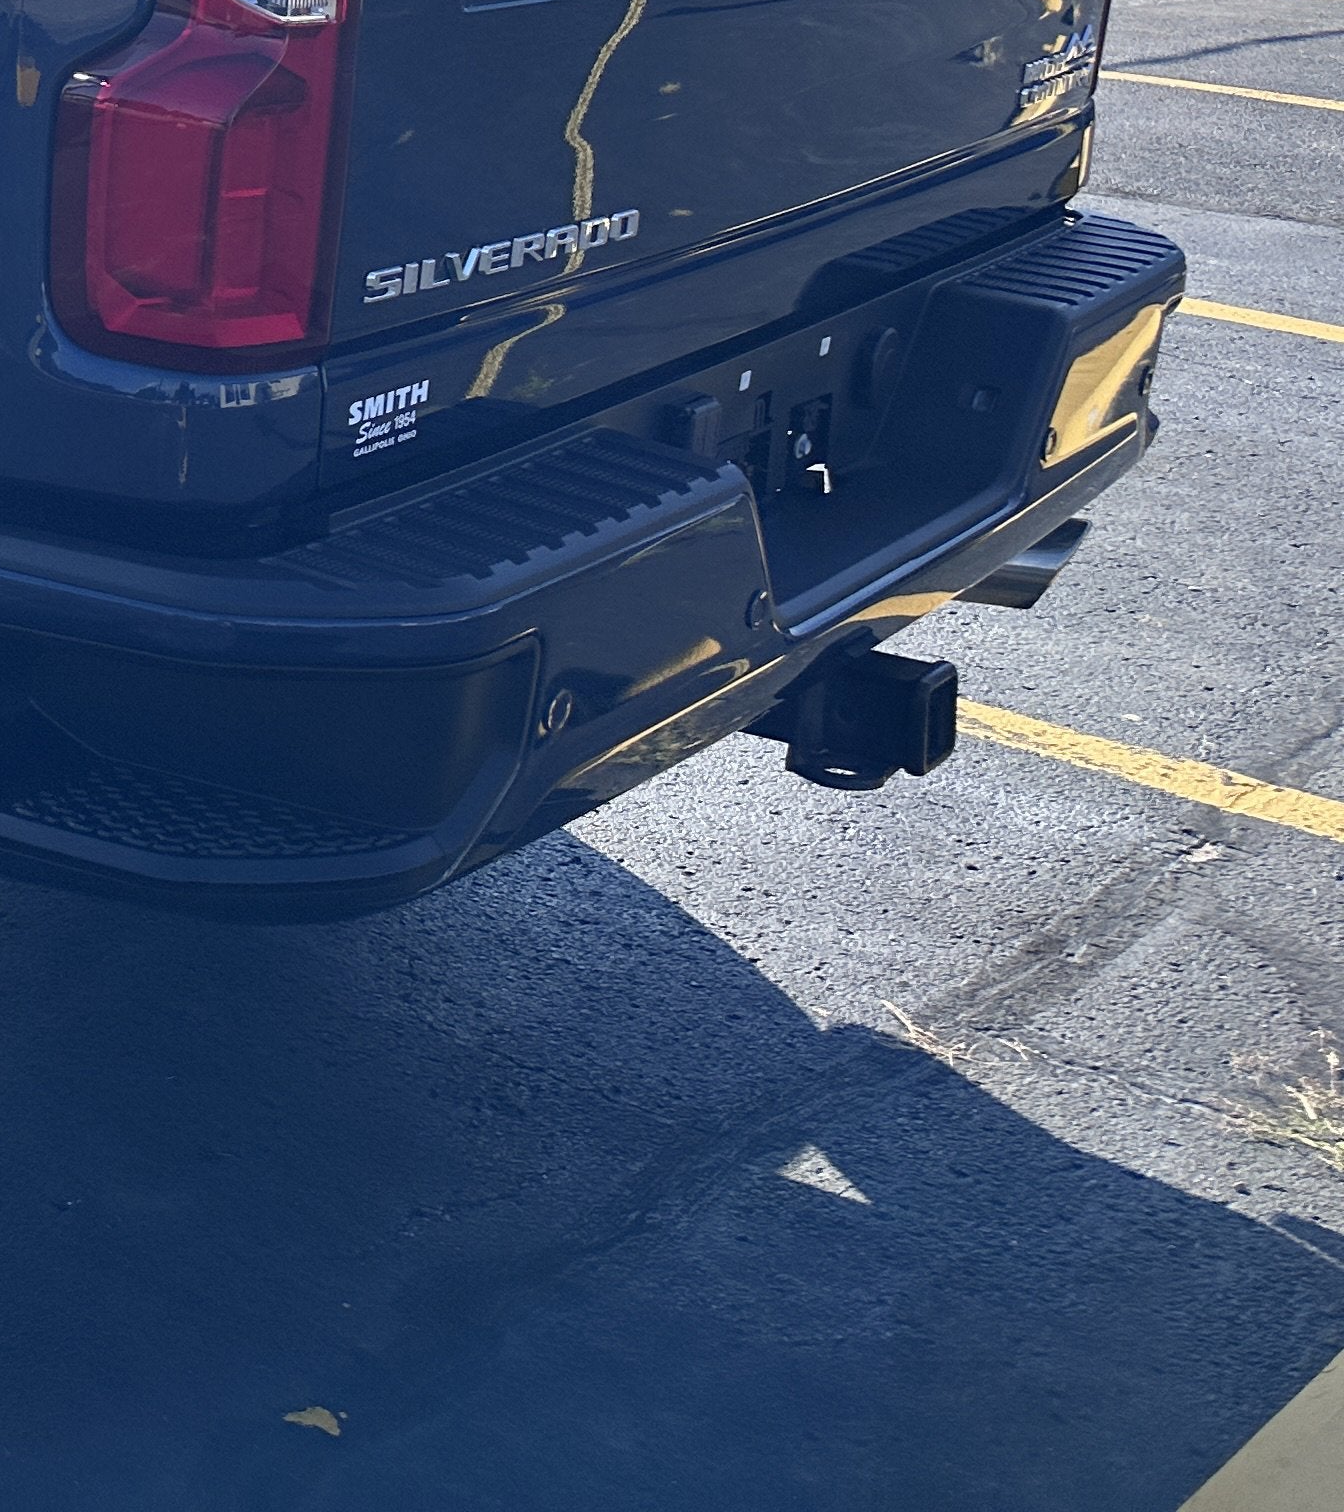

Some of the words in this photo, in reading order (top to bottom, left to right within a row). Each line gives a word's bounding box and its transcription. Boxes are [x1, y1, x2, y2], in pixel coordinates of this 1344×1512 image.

[363, 208, 640, 304] SILVERADO
[348, 379, 430, 426] SMITH
[353, 436, 396, 458] GALLIPOLIS
[355, 421, 392, 445] Since
[393, 409, 417, 430] 1954
